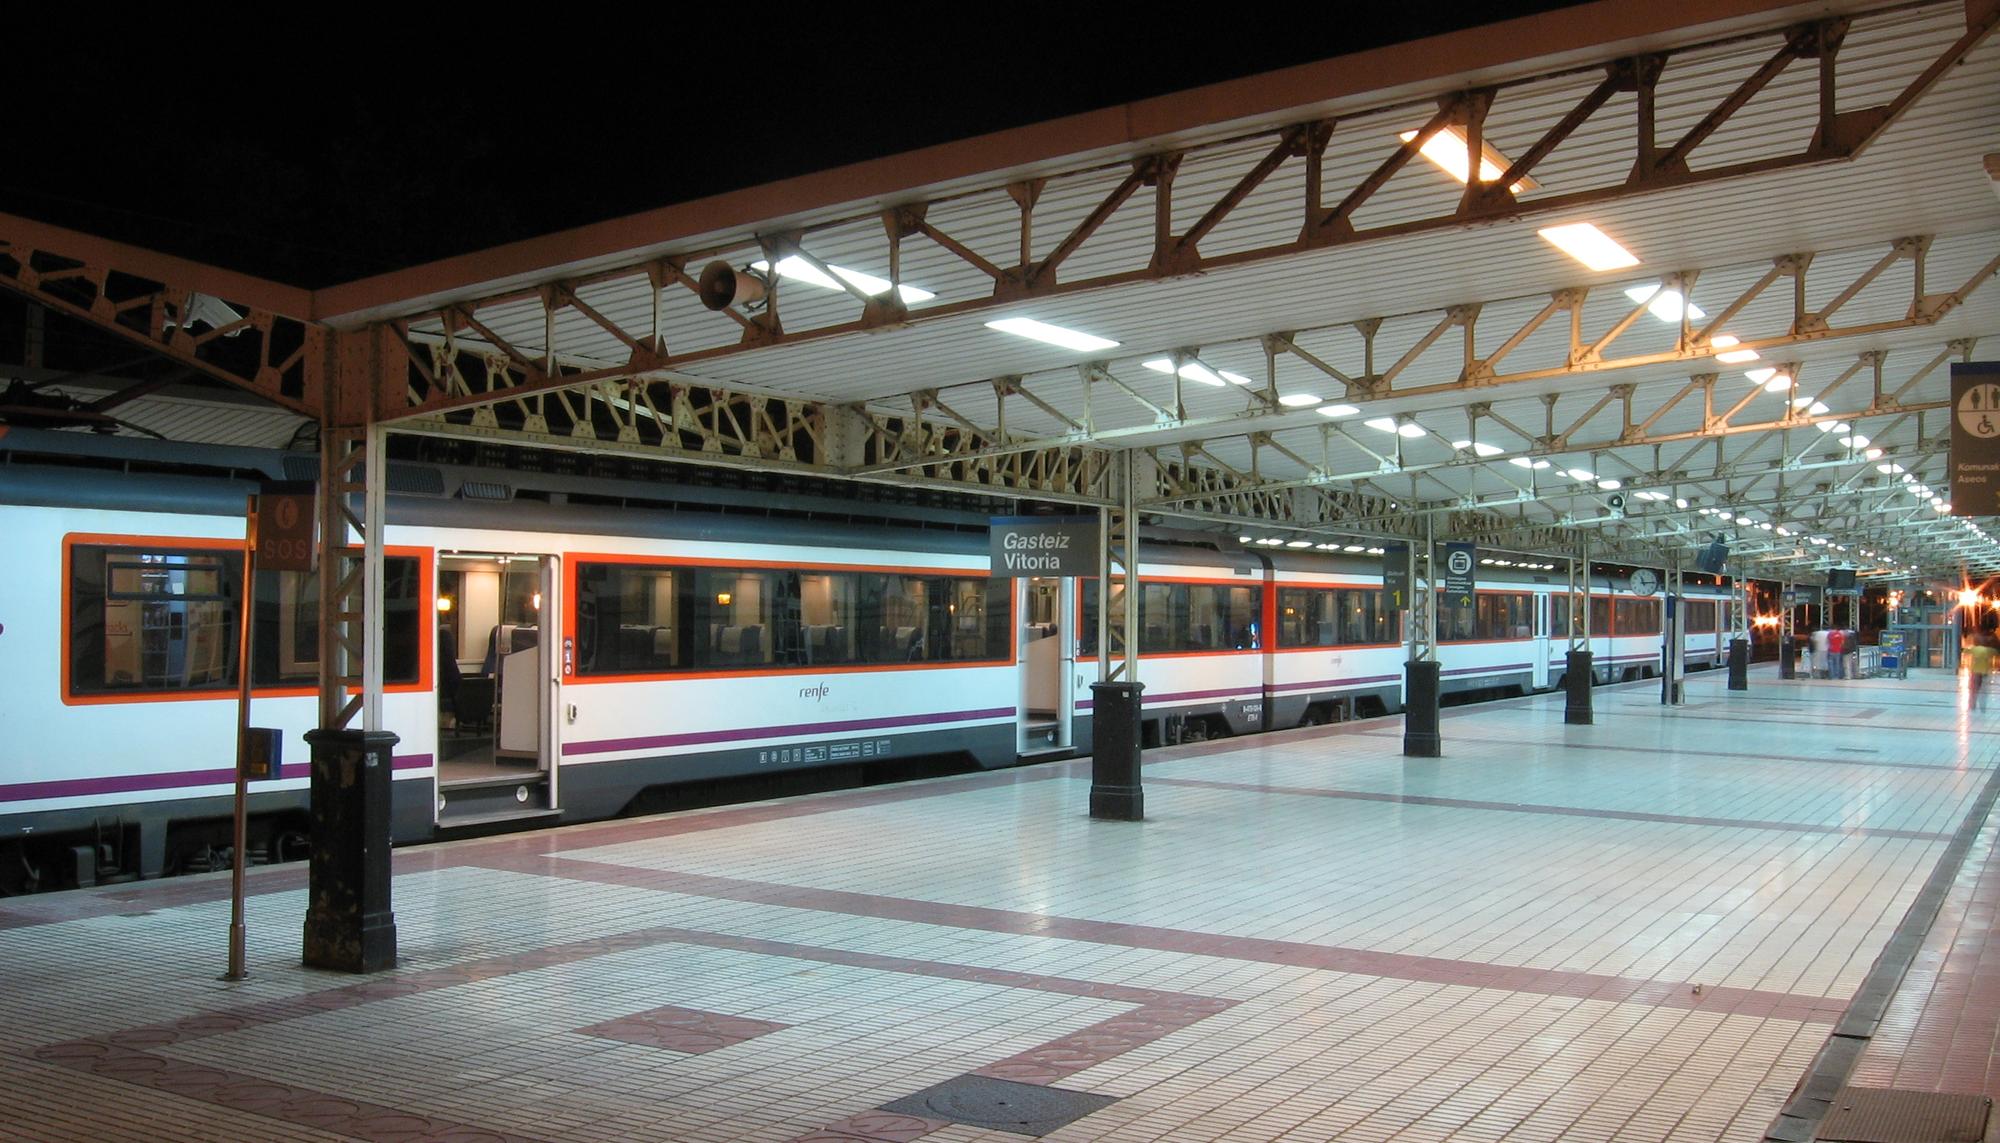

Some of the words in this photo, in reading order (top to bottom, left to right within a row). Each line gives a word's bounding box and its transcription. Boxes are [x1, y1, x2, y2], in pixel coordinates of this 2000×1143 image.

[264, 539, 307, 560] SOS
[1003, 532, 1070, 550] Gasteiz
[1004, 552, 1060, 570] Vitoria
[1392, 590, 1400, 607] 1
[799, 681, 830, 703] renfe
